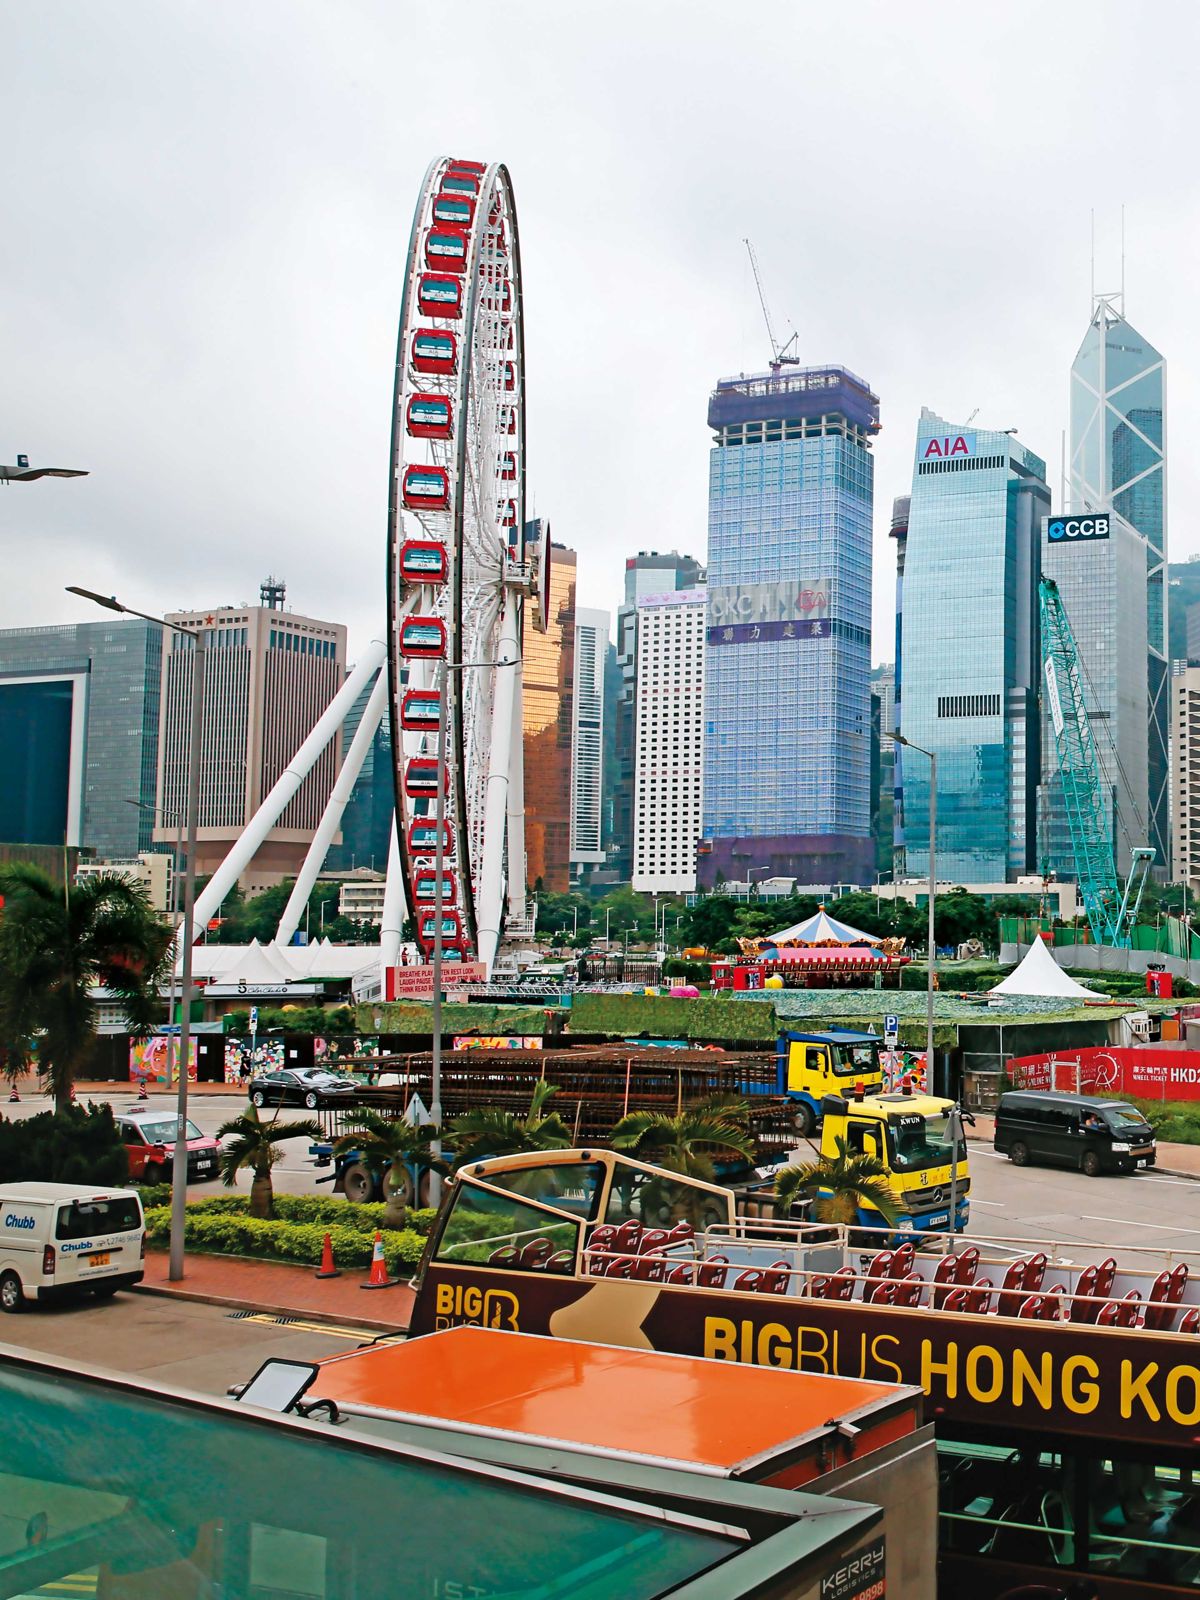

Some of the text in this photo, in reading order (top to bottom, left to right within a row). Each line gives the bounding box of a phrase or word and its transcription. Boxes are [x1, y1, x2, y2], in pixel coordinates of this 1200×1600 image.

[924, 436, 969, 458] AIA
[1065, 519, 1109, 538] CCB
[400, 970, 420, 978] BREATHE
[463, 967, 474, 975] LOOK
[400, 985, 413, 993] THINK
[886, 1016, 896, 1030] P
[900, 1116, 920, 1126] KWUN
[5, 1214, 36, 1229] Chubb
[61, 1241, 93, 1253] Chubb
[436, 1284, 482, 1318] BIG
[920, 1338, 1100, 1415] HONG
[822, 1545, 885, 1594] KERRY
[831, 1567, 876, 1600] LOGISTICS
